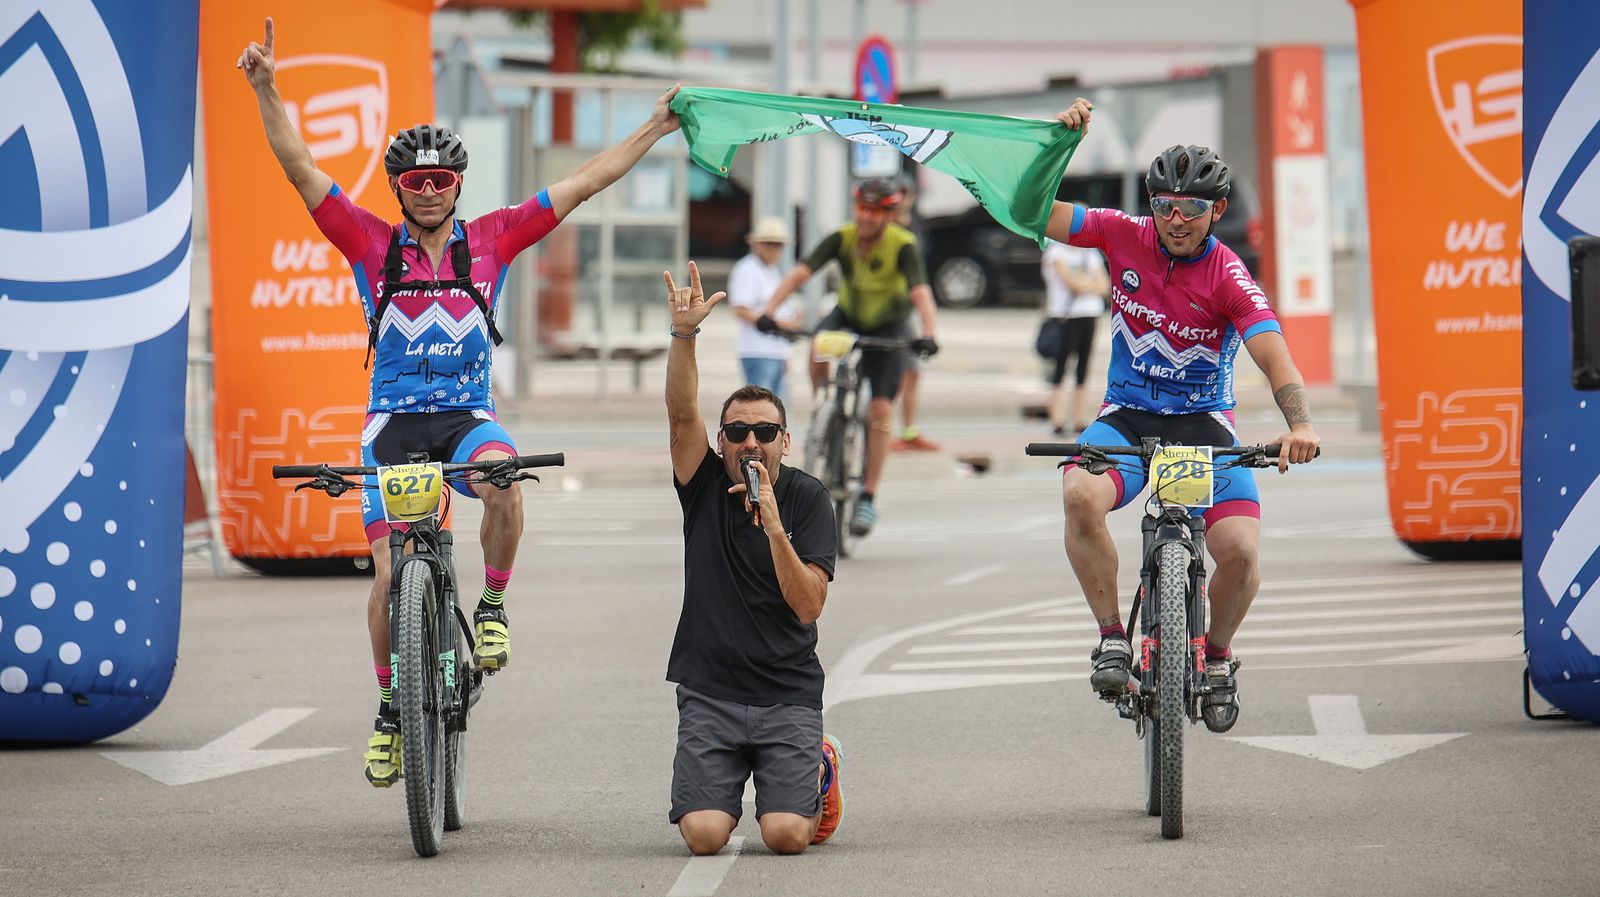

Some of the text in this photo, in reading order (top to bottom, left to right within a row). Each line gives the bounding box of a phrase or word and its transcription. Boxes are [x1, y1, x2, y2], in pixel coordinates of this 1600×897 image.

[1445, 218, 1507, 253] WE
[271, 237, 330, 272] WE
[1423, 256, 1522, 290] NUTRI
[250, 276, 359, 308] NUTRIT
[1112, 285, 1218, 342] SIEMPRE HASTA
[1435, 311, 1522, 333] www.hsn
[405, 343, 464, 357] LA META
[1131, 356, 1187, 380] LA META
[1163, 449, 1197, 460] Sherry
[1156, 462, 1206, 479] 628
[386, 473, 436, 496] 627
